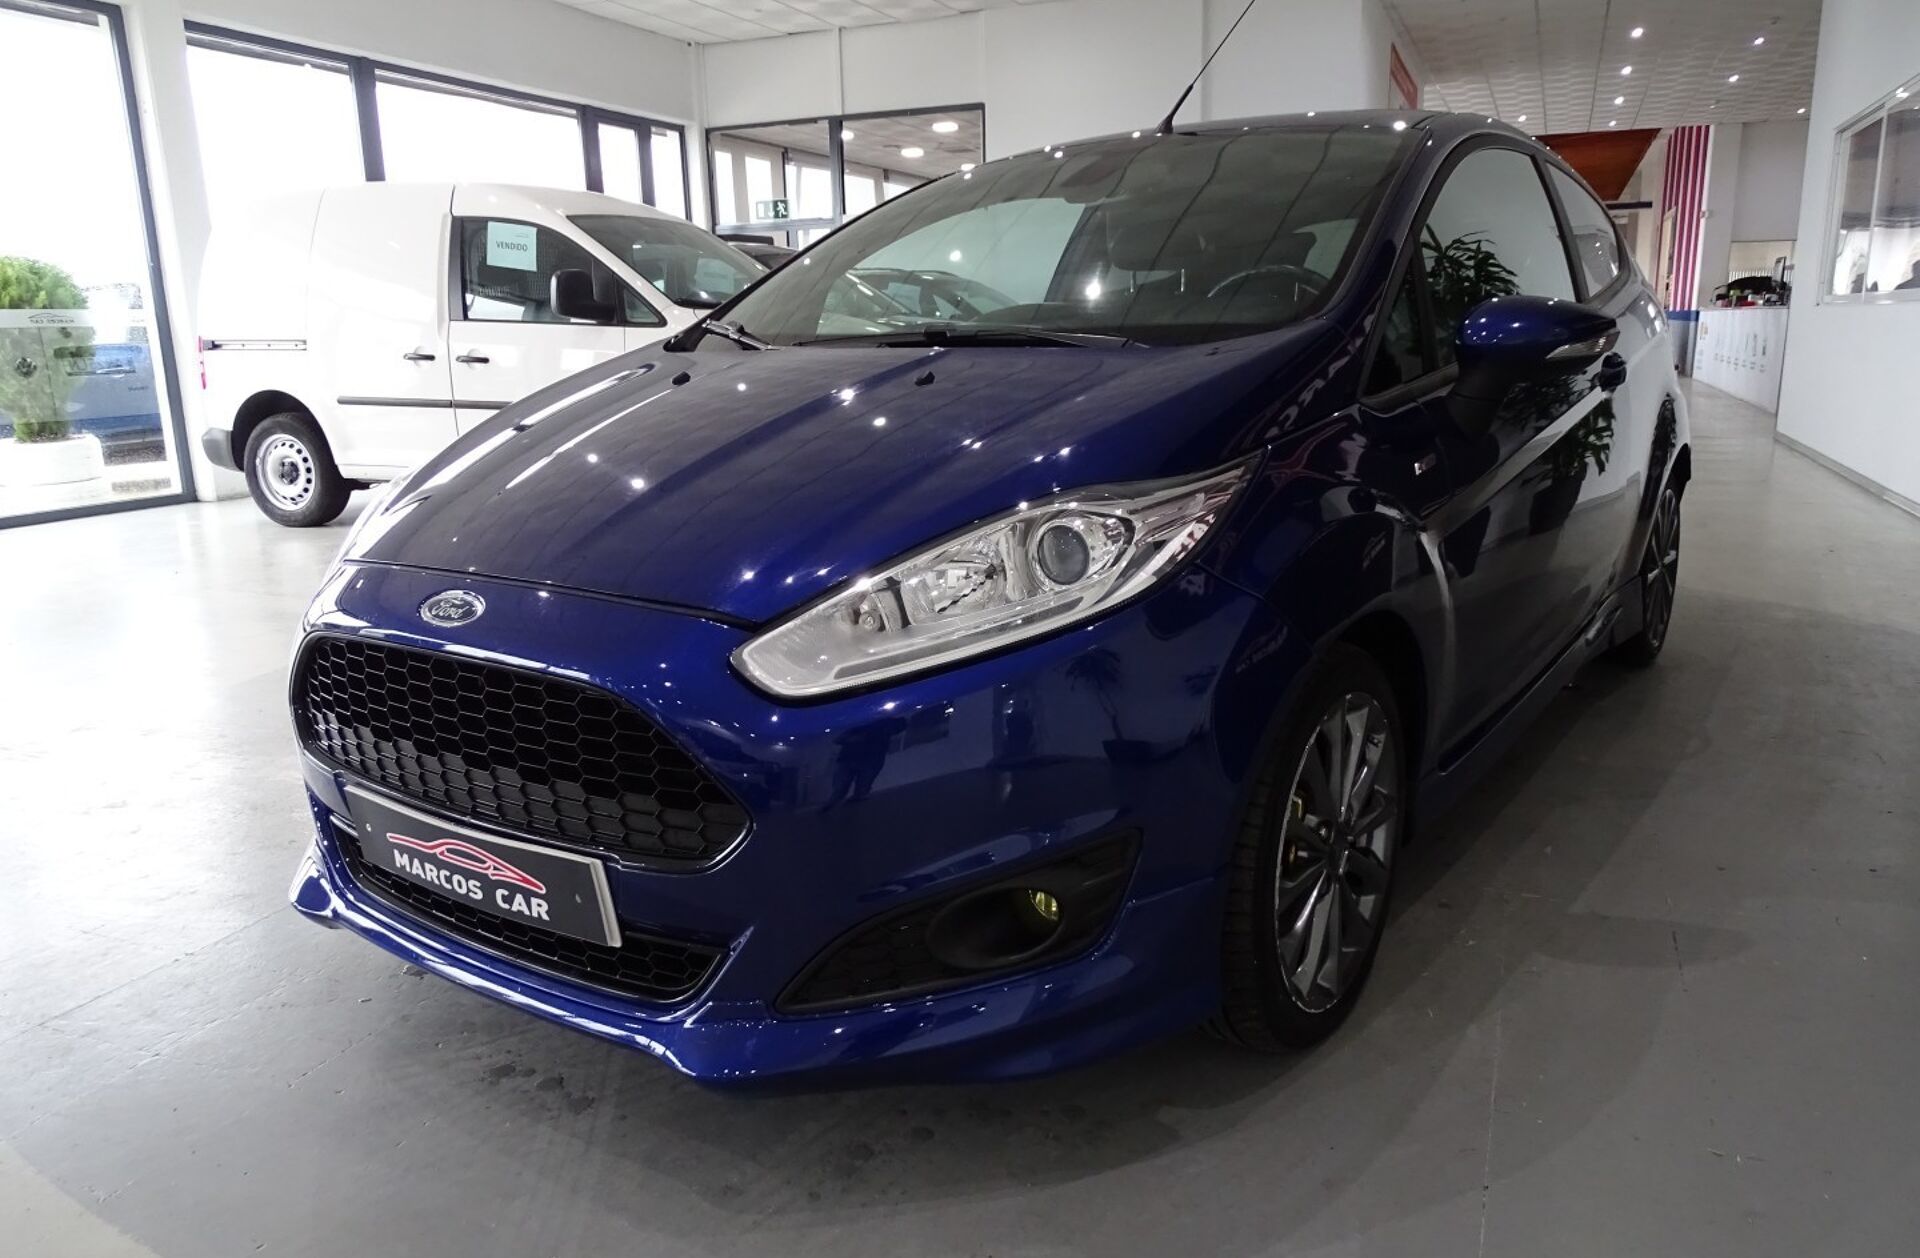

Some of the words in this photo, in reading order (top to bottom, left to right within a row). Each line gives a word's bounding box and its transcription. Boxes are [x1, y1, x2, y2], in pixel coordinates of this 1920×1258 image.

[496, 240, 528, 252] VENDIDO
[431, 598, 470, 619] Ford
[394, 849, 483, 900] MARCOS
[495, 888, 550, 921] CAR
